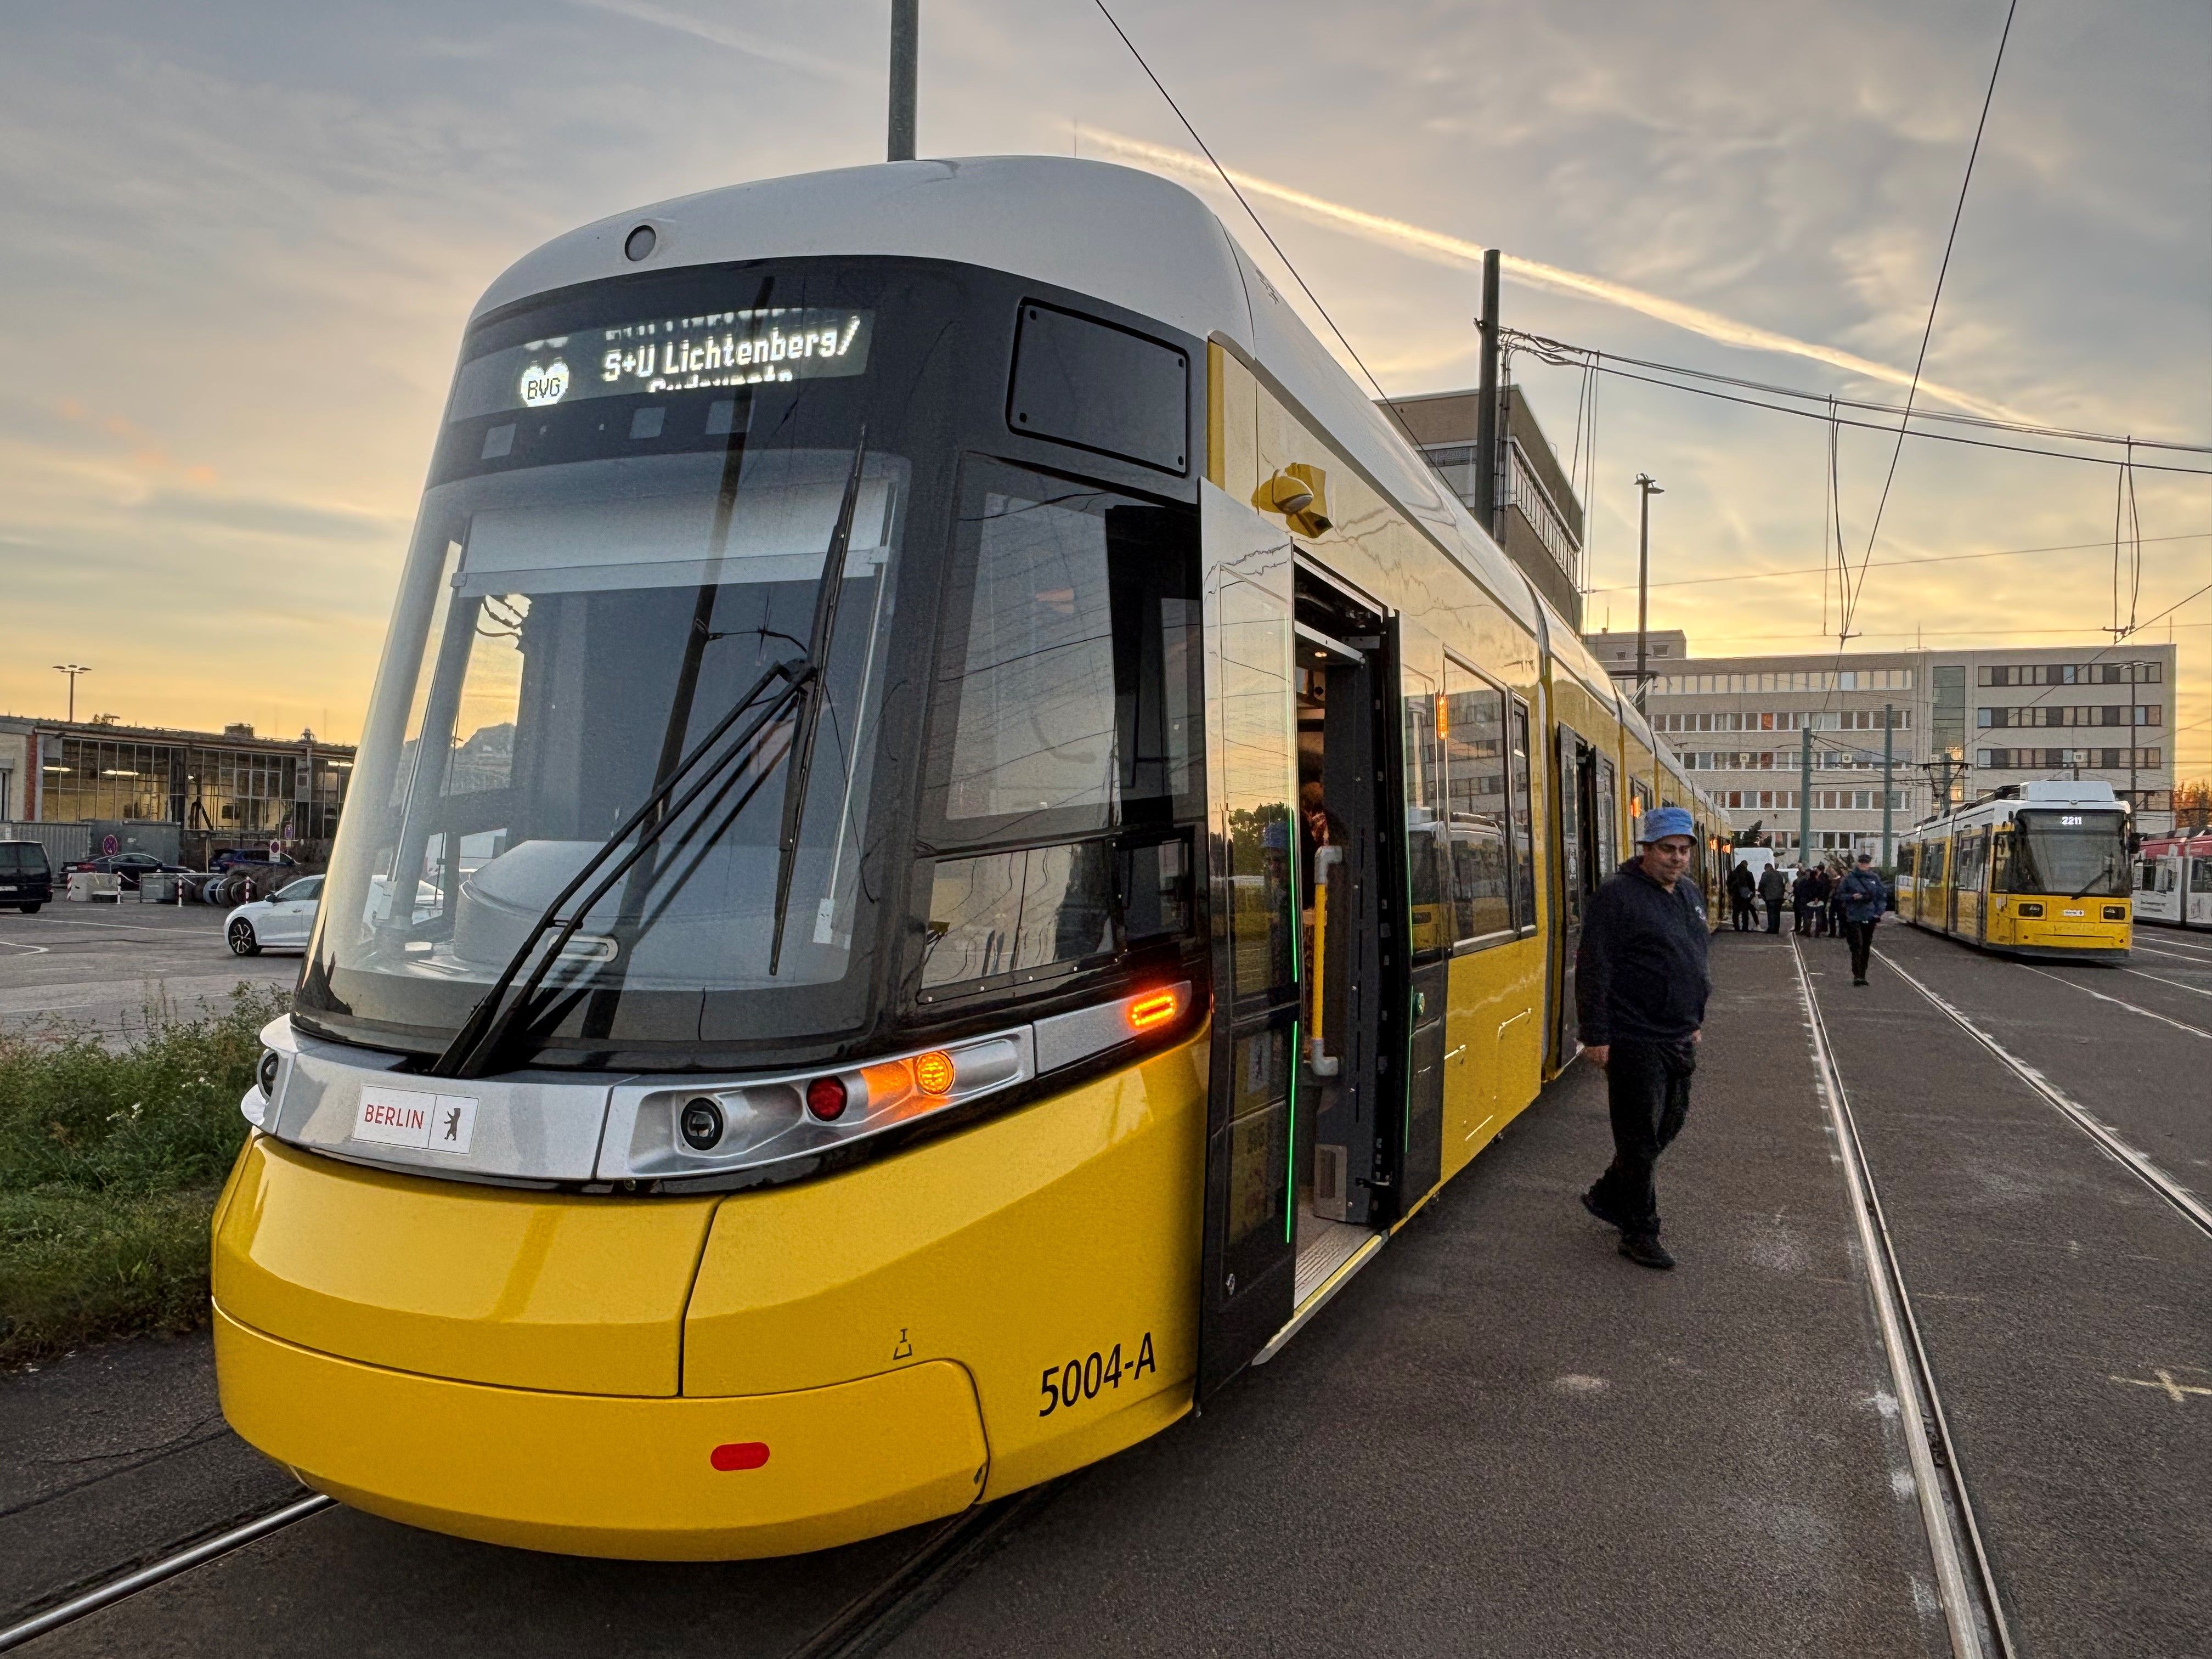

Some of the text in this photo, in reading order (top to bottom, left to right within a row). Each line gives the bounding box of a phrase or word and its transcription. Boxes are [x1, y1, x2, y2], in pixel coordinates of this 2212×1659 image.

[601, 345, 655, 381] S+U
[661, 315, 861, 375] Lichtenberg/
[527, 377, 561, 400] BVG
[2061, 816, 2083, 826] 2211
[364, 1104, 425, 1130] BERLIN
[1039, 1331, 1156, 1418] 5004-A
